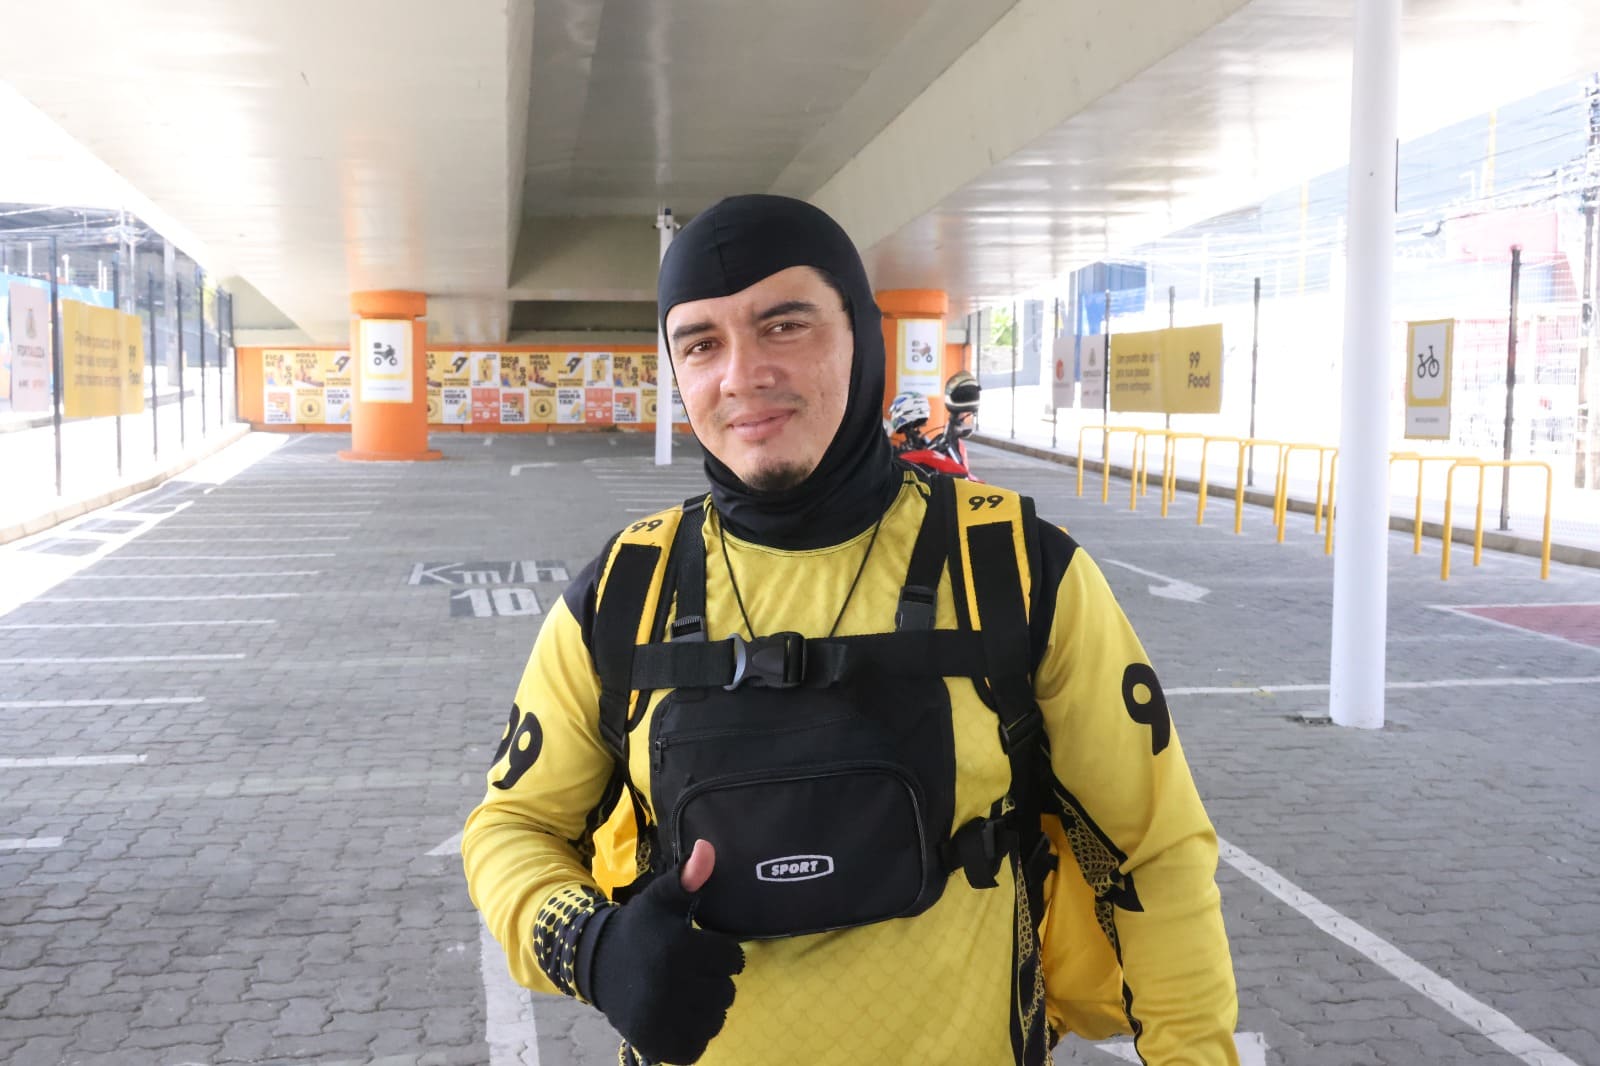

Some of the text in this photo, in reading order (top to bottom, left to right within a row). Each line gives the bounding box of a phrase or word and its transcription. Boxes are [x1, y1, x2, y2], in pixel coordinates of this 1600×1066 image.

[1189, 351, 1200, 368] 99
[1187, 371, 1211, 388] Food
[968, 495, 1004, 511] 99
[630, 519, 663, 533] 99
[408, 560, 569, 585] Km/h
[451, 588, 542, 617] 10
[771, 860, 818, 876] SPORT
